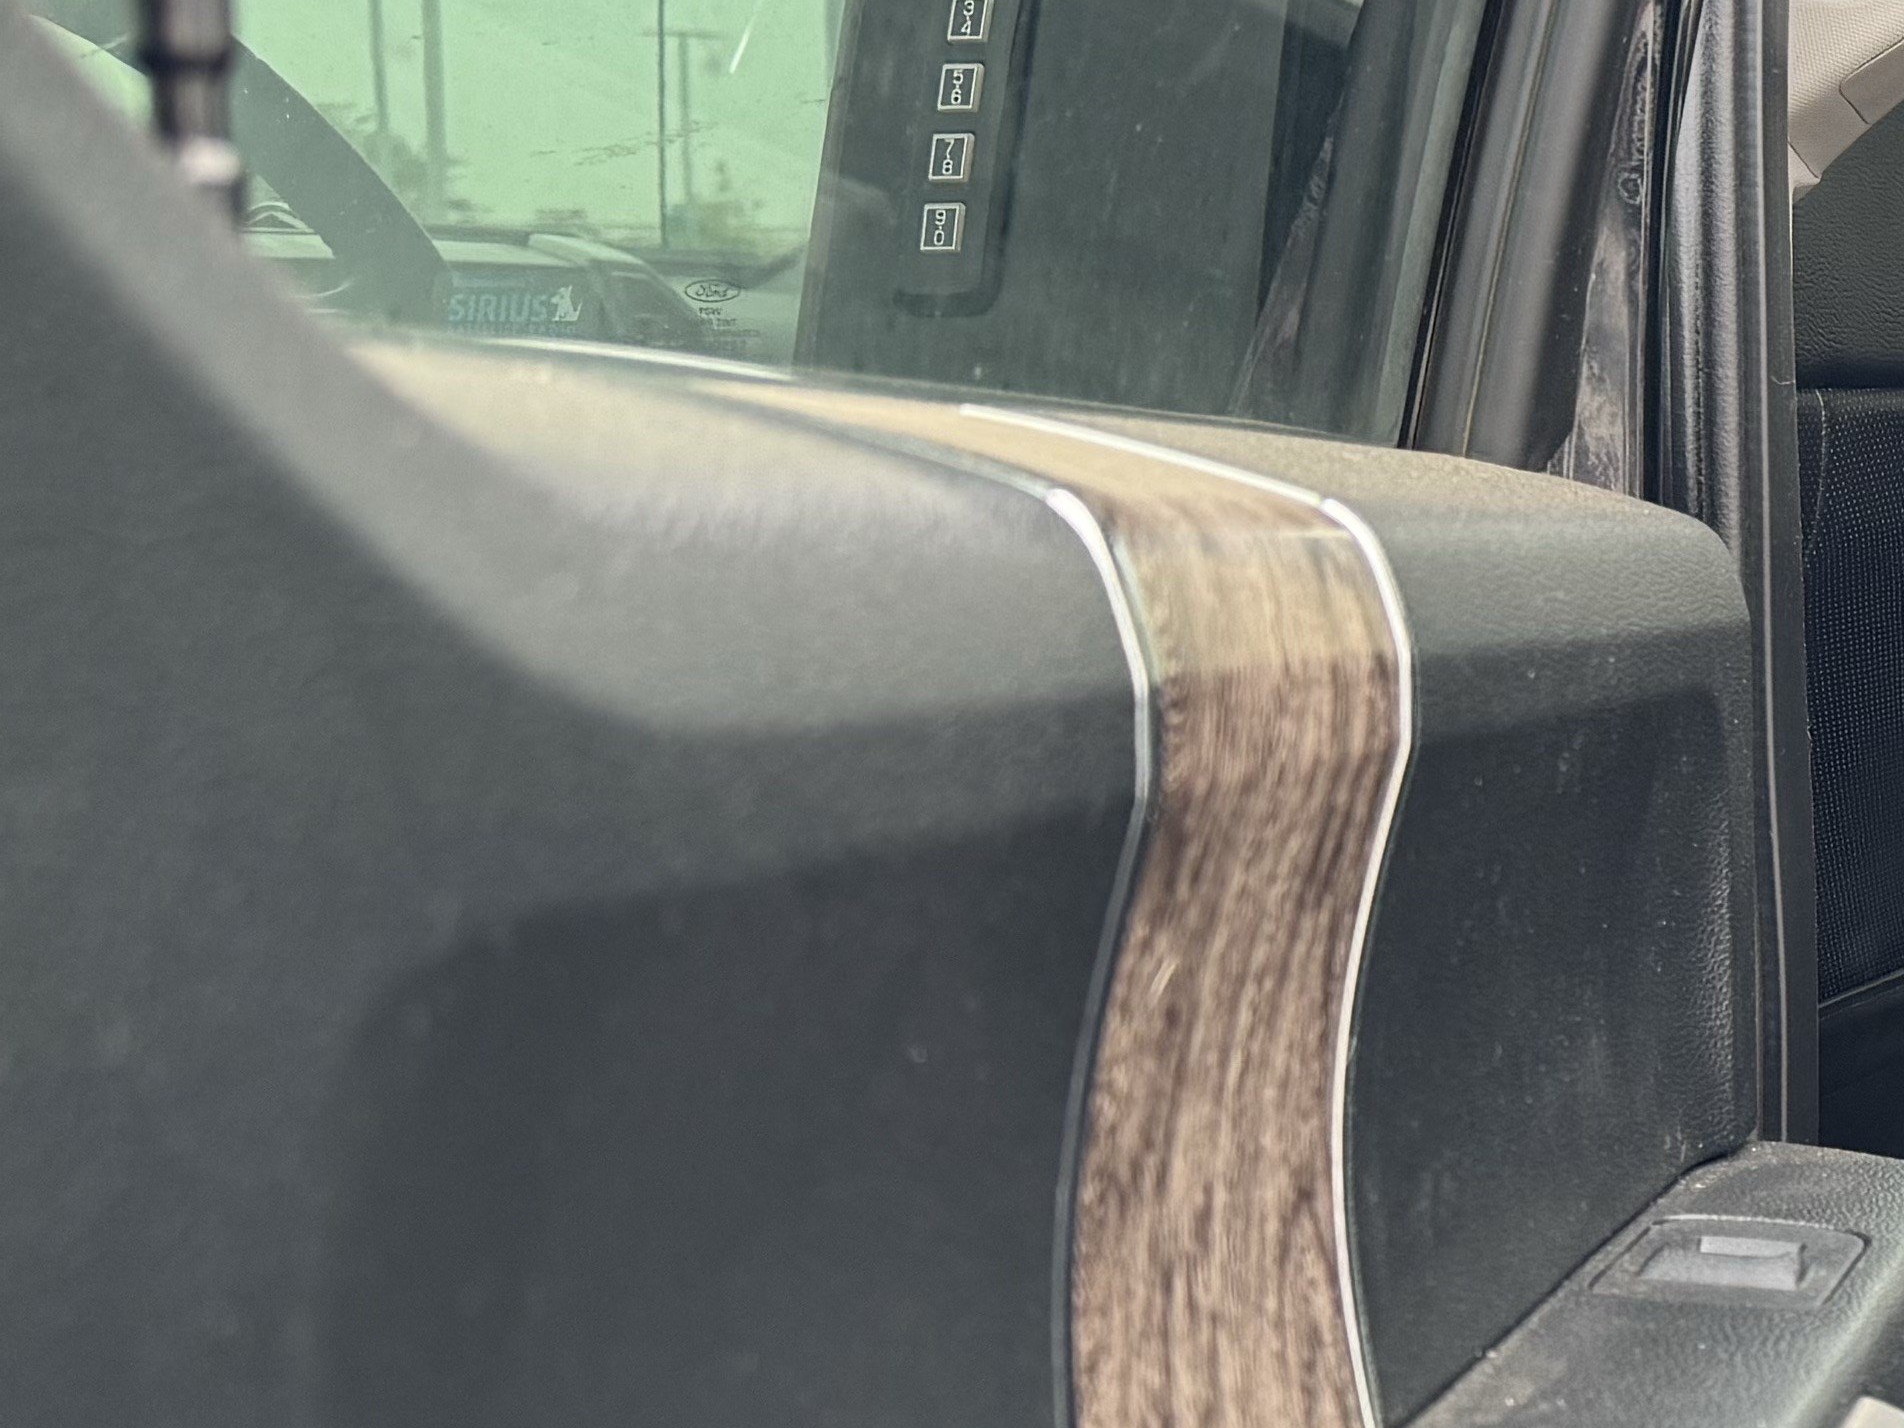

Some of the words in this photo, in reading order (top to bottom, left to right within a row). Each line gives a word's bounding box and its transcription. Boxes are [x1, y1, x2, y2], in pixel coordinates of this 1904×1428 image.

[962, 0, 975, 16] 3
[960, 21, 972, 36] 4
[952, 70, 964, 85] 5
[950, 88, 962, 104] 6
[944, 138, 955, 154] 7
[942, 159, 953, 175] 8
[935, 209, 946, 226] 9
[933, 230, 945, 246] 0
[449, 293, 549, 323] SIRIUS
